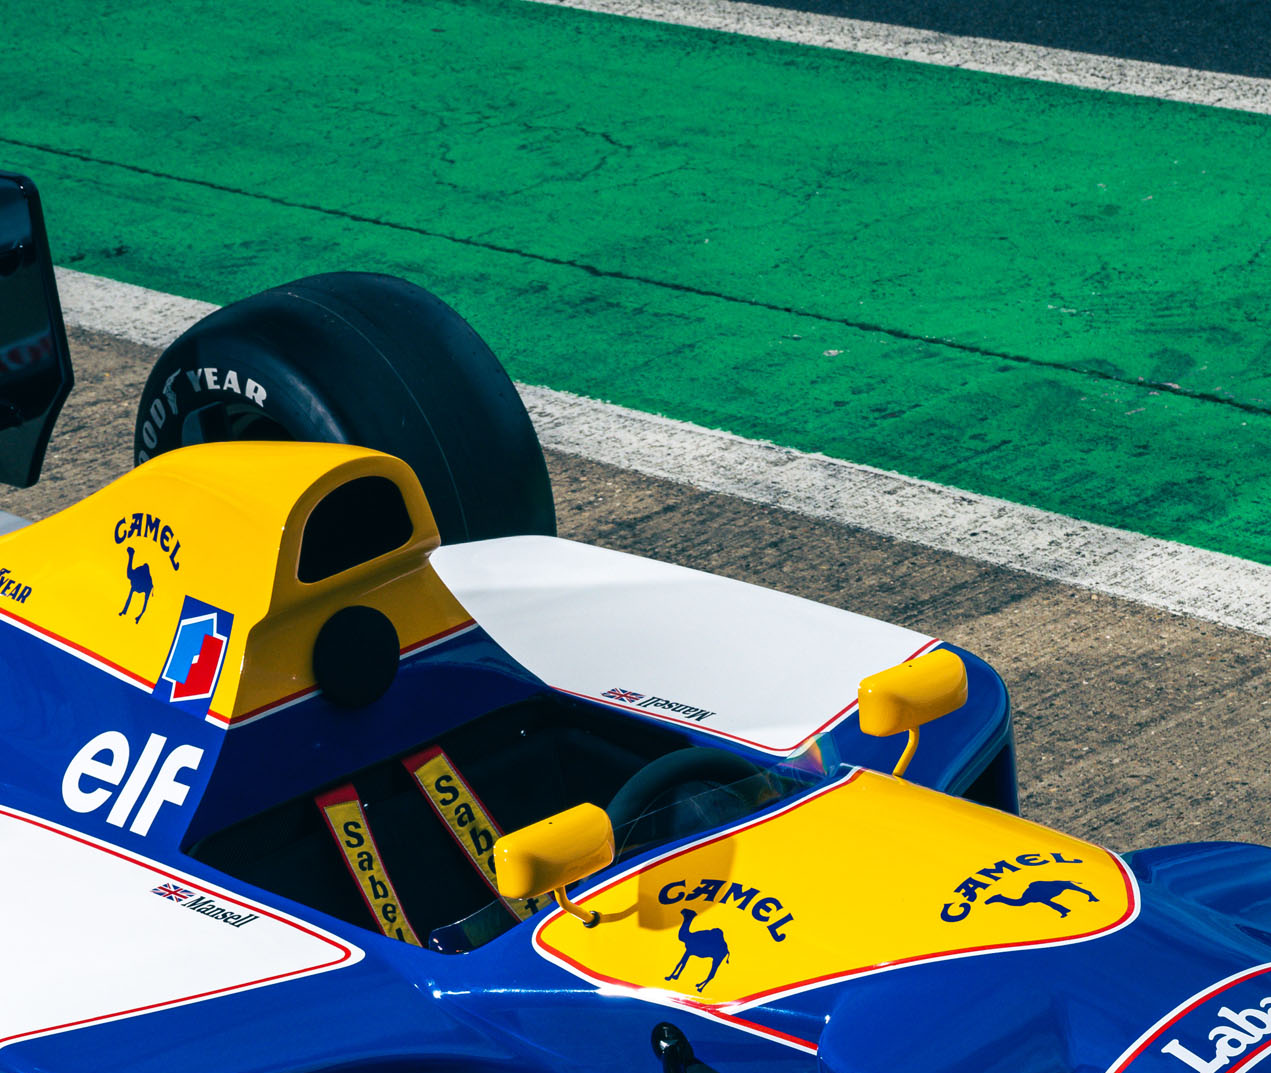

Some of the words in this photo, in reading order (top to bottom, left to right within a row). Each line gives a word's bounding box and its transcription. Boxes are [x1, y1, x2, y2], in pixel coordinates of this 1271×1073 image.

[138, 367, 268, 464] ODYEAR
[114, 513, 180, 572] CAMEL
[636, 696, 717, 722] Mansell
[61, 730, 204, 837] elf
[181, 895, 259, 928] Mansell
[343, 821, 406, 943] Sabe
[658, 878, 795, 943] CAMEL
[939, 852, 1084, 924] CAMEL
